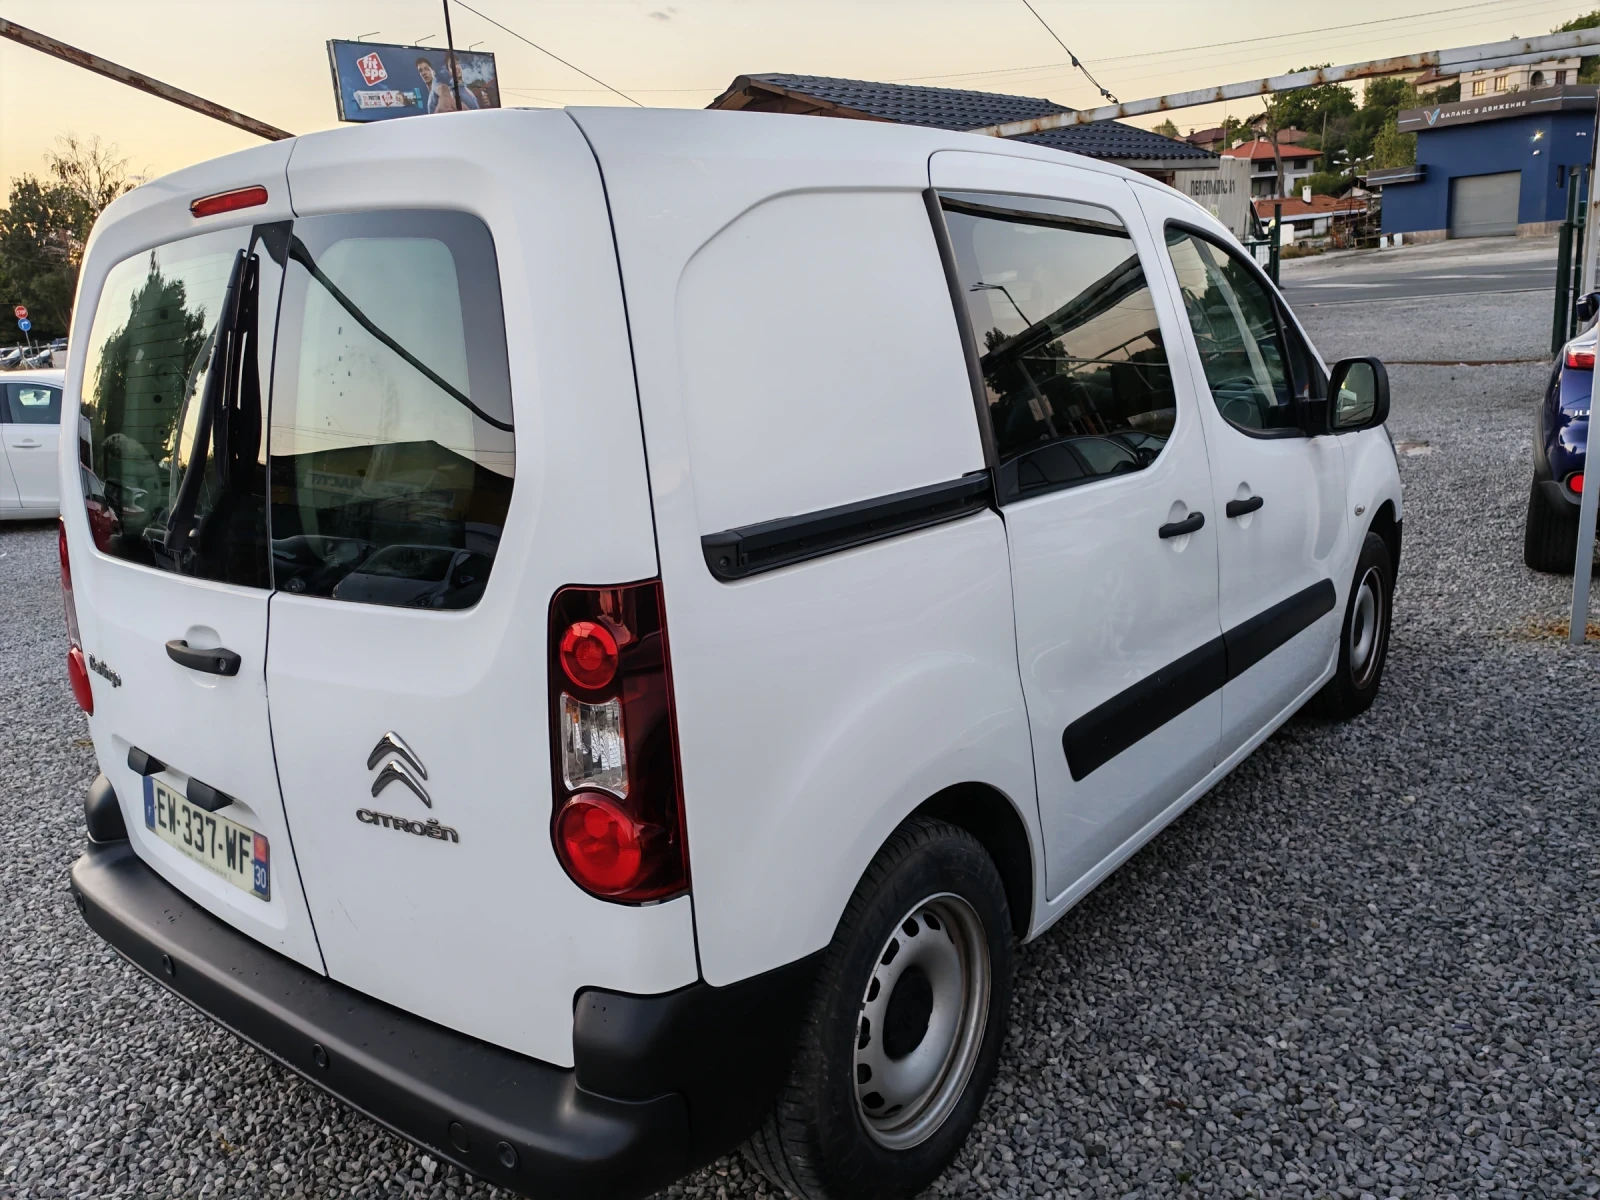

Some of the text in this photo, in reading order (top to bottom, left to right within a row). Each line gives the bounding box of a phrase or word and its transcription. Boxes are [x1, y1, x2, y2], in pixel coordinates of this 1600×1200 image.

[363, 56, 378, 69] fit
[365, 68, 386, 80] spo
[1440, 110, 1471, 119] БАЛАНС
[1482, 100, 1527, 113] ДВИЖЕНИЕ
[157, 787, 251, 874] EW-337-WF
[254, 865, 267, 889] 30
